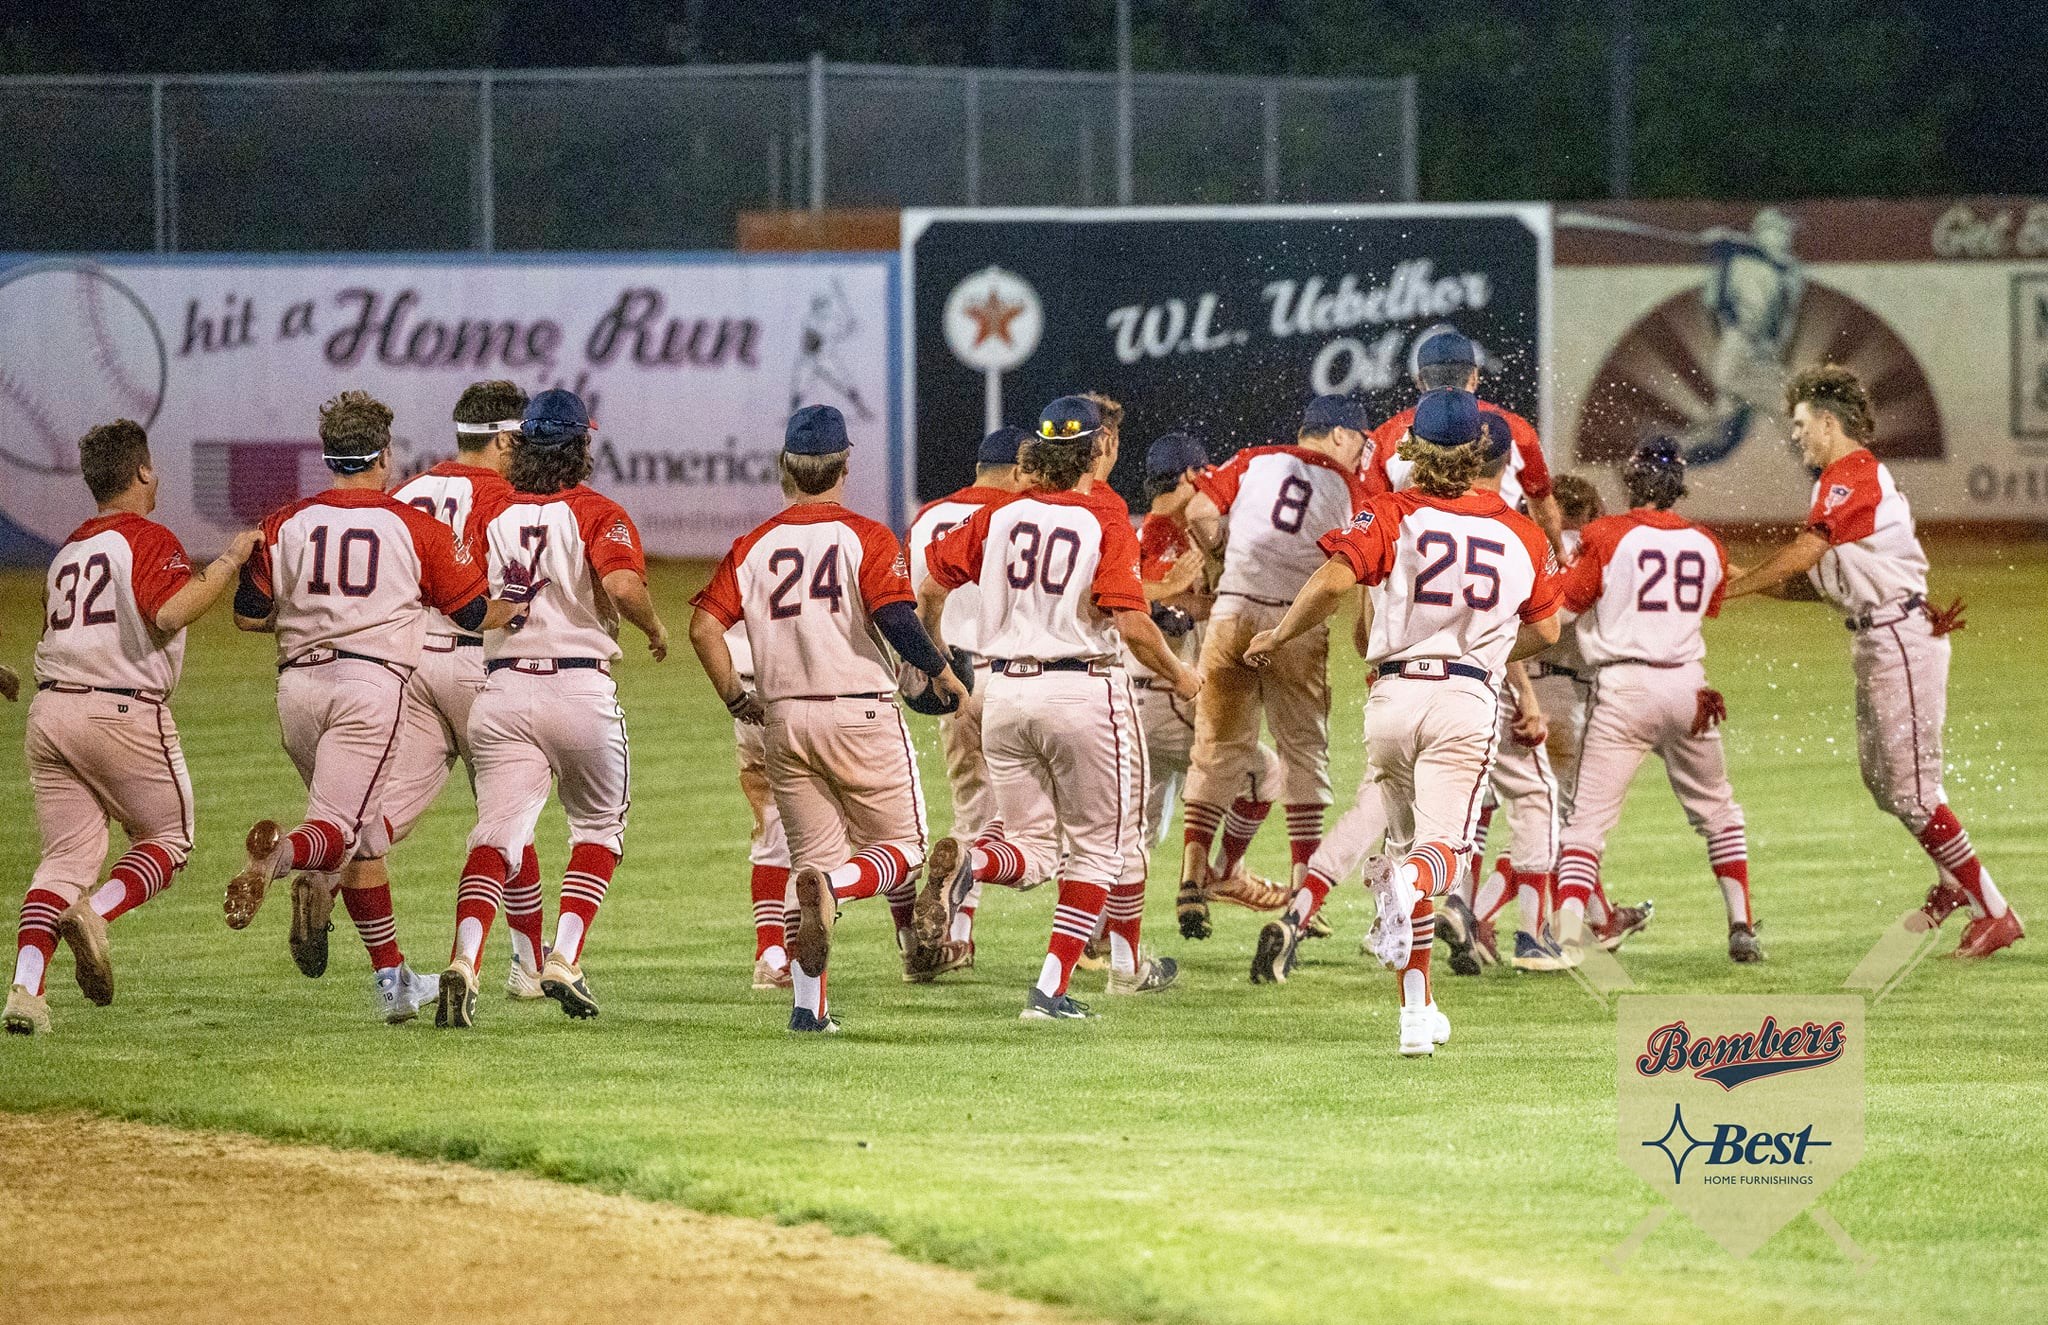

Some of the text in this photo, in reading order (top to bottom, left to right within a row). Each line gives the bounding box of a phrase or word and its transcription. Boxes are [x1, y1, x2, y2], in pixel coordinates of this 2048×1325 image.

[178, 286, 760, 369] hit a Home Run
[1271, 474, 1313, 535] 8
[307, 525, 380, 598] 10
[520, 525, 549, 582] 7
[768, 544, 843, 621] 24
[1006, 521, 1082, 596] 30
[1413, 529, 1506, 613] 25
[1637, 549, 1706, 612] 28
[50, 552, 117, 631] 32
